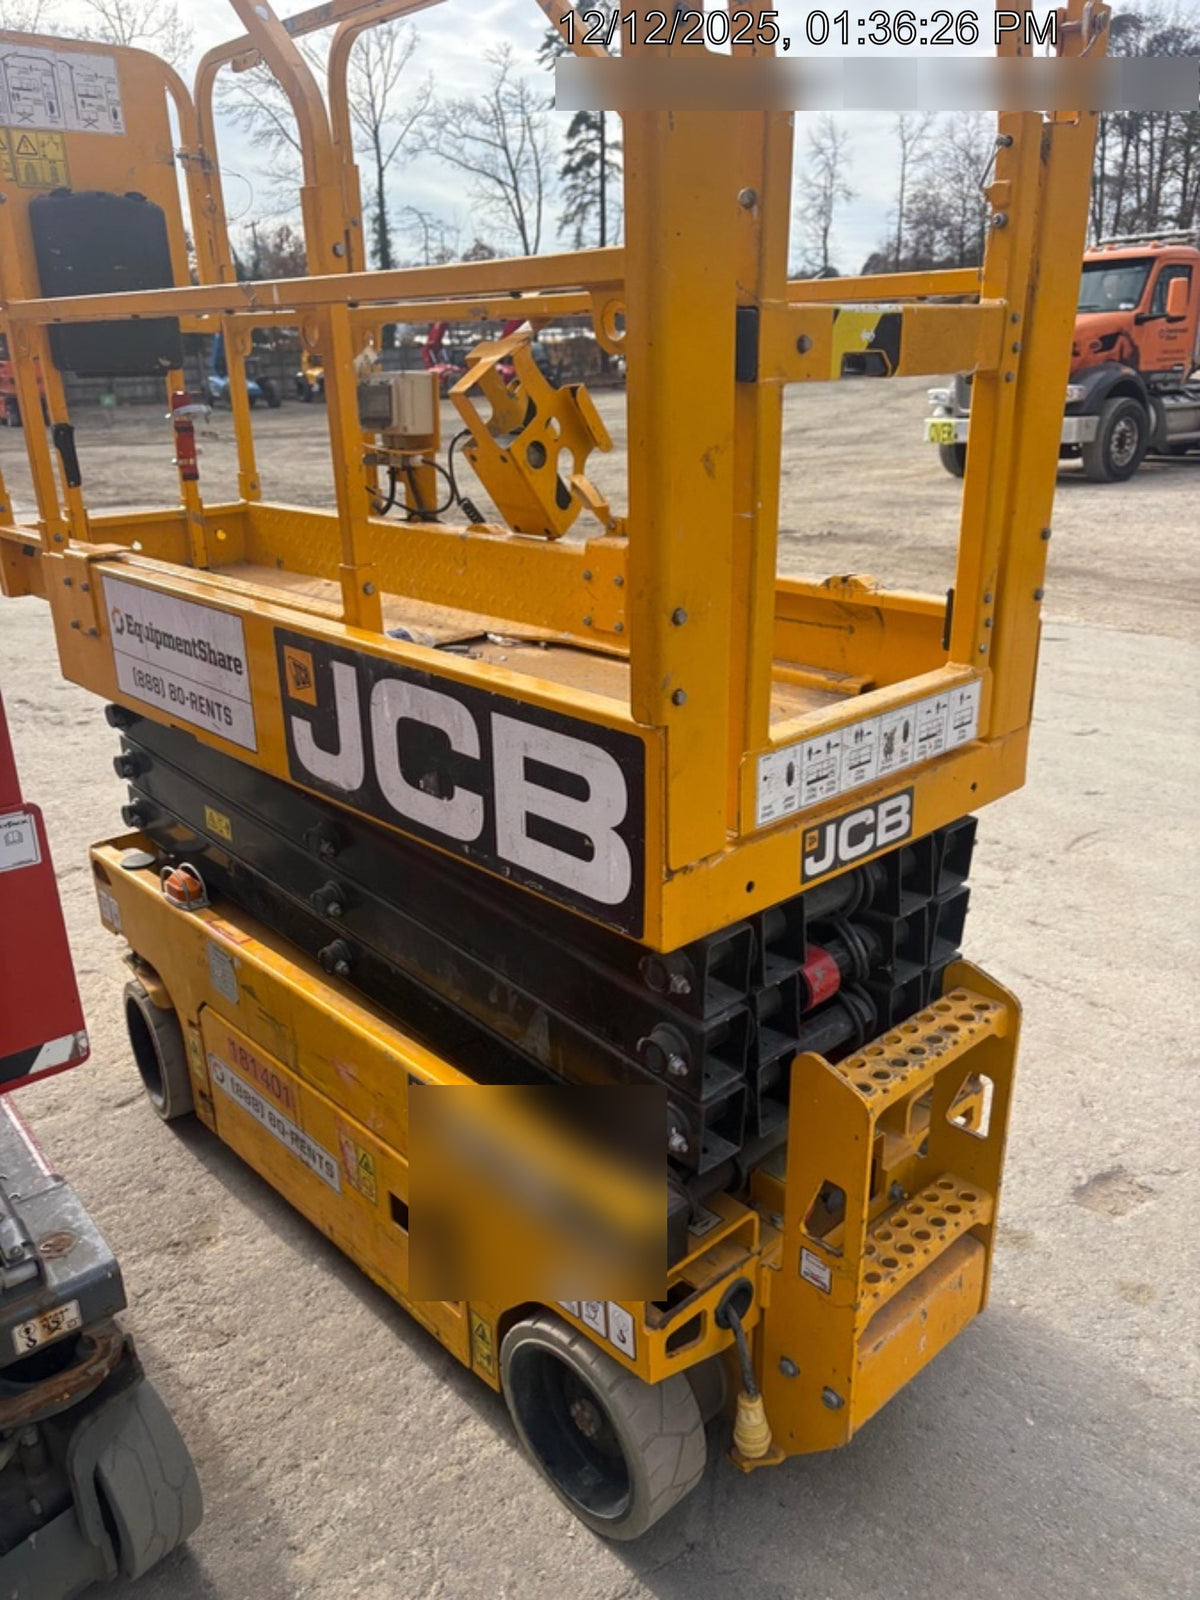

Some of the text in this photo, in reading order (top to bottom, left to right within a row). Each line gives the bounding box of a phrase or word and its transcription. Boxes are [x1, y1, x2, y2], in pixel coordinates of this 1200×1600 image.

[124, 612, 243, 676] EquipmentShare
[132, 666, 233, 726] (888) 80-RENTS
[290, 660, 632, 905] JCB
[804, 794, 911, 876] JCB
[227, 1037, 293, 1107] 181401
